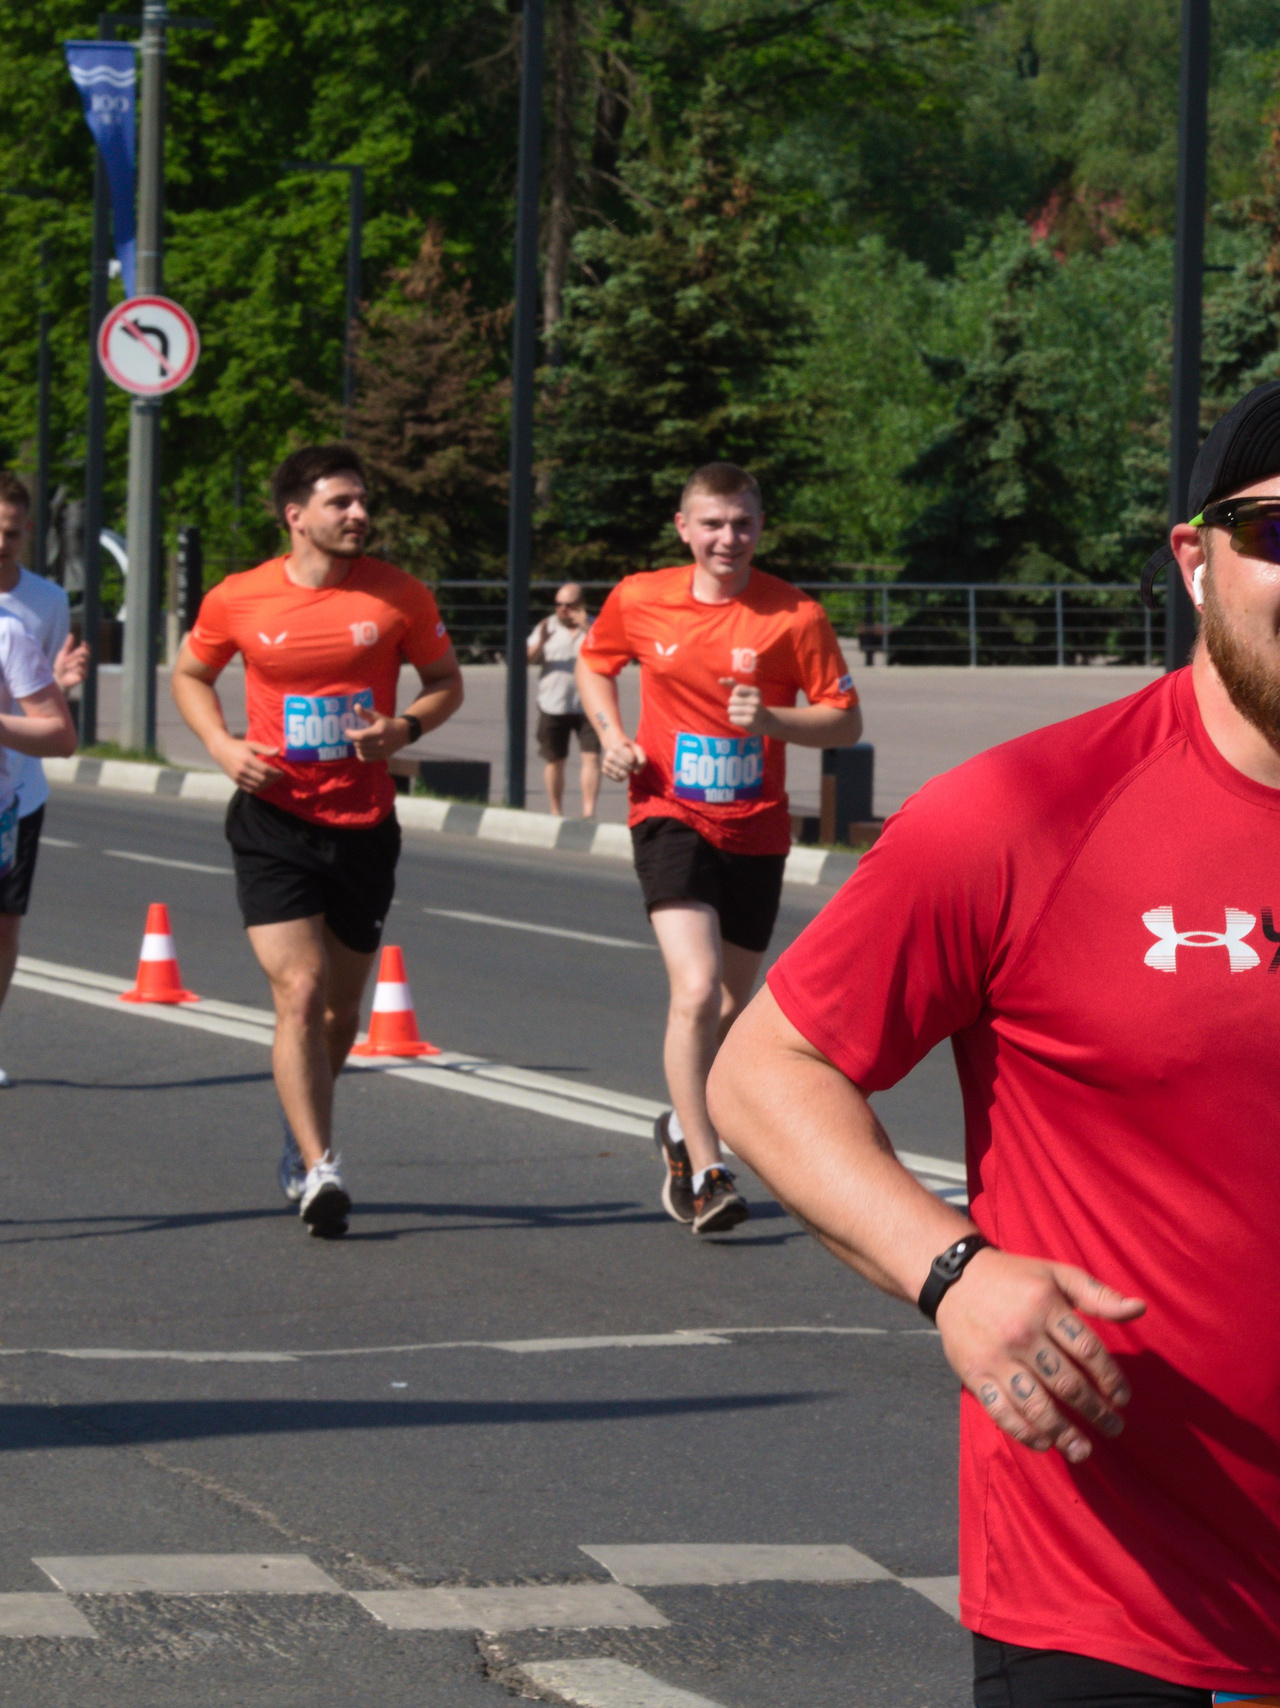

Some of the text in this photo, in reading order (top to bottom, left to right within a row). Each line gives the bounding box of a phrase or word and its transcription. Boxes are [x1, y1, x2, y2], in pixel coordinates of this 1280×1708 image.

[349, 621, 378, 647] 10
[732, 647, 758, 674] 10
[287, 711, 372, 748] 5009
[681, 752, 758, 787] 50100
